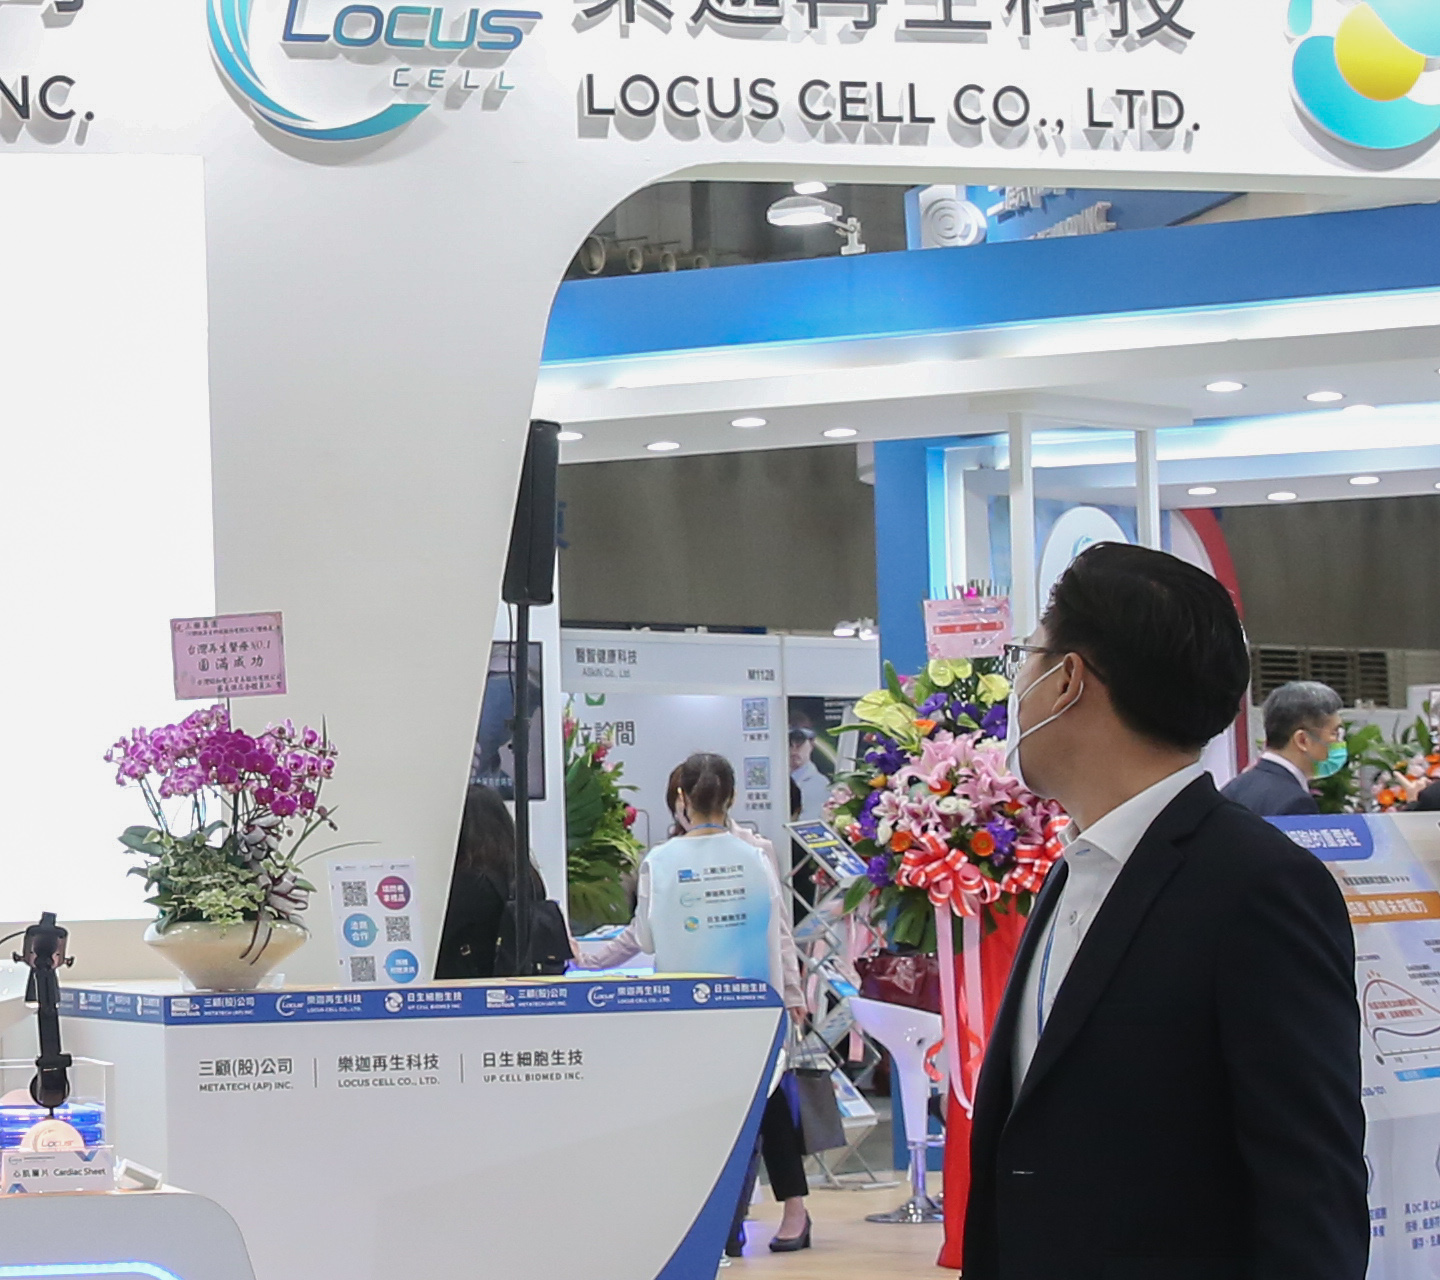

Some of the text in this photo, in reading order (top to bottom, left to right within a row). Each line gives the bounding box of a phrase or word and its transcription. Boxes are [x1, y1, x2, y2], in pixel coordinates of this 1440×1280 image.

[391, 66, 516, 90] CELL
[585, 73, 1201, 137] LOCUS CELL CO., LTD.
[198, 1057, 293, 1077] 三顧(股)公司
[338, 1053, 440, 1073] 樂迦再生科技
[483, 1049, 583, 1069] 日生細胞生技
[199, 1082, 251, 1092] METATECH
[338, 1078, 370, 1088] LOCUS
[372, 1078, 395, 1087] CELL
[484, 1074, 497, 1083] UP
[499, 1073, 523, 1082] CELL
[525, 1072, 562, 1081] BIOMED
[84, 1167, 106, 1176] Sheet
